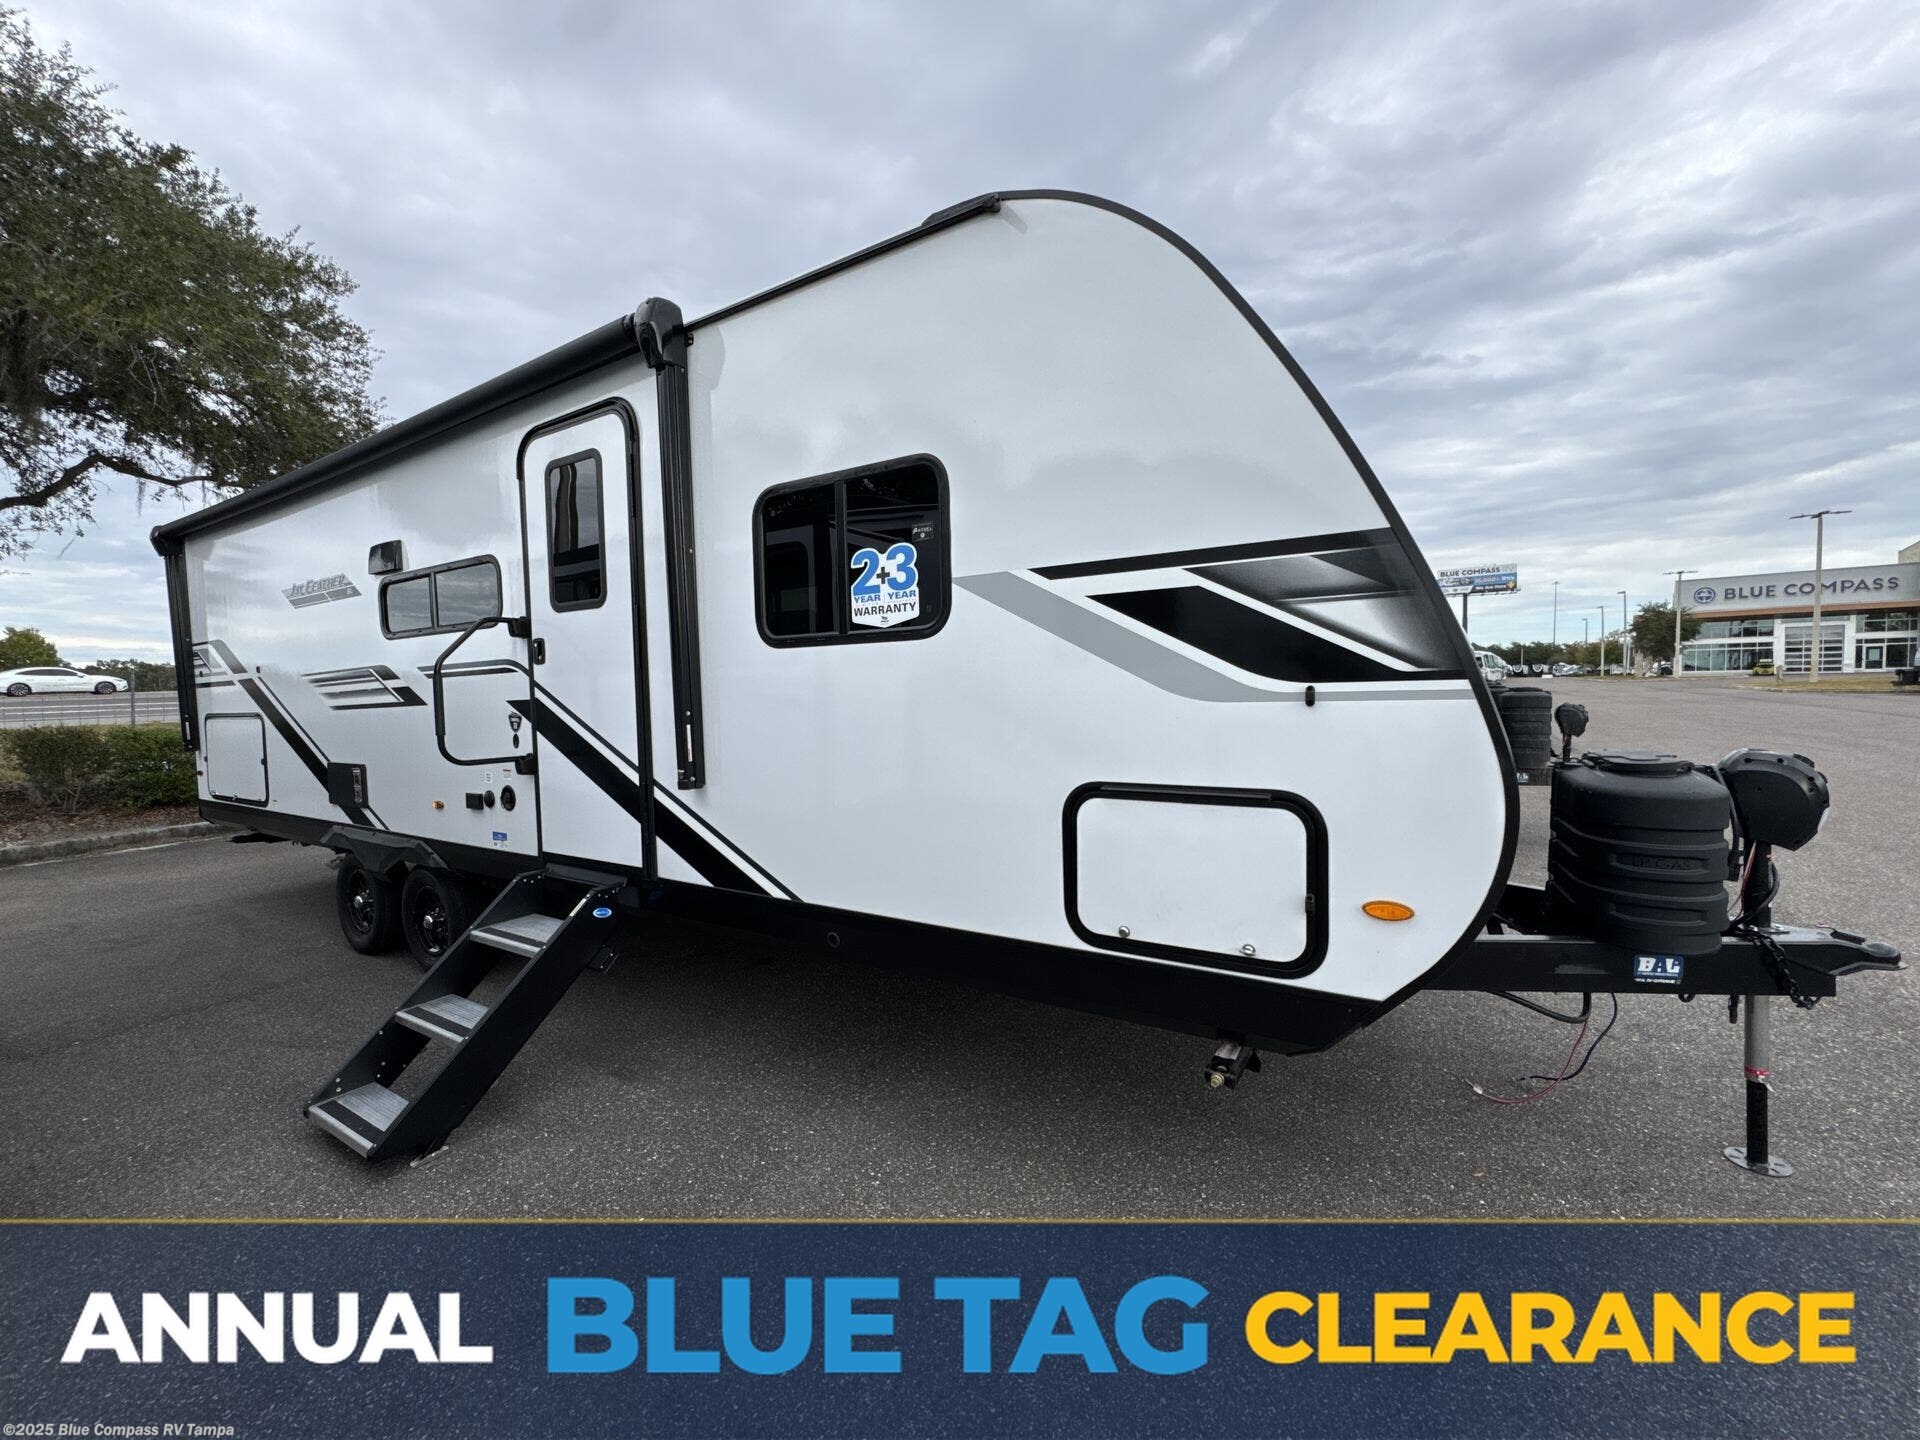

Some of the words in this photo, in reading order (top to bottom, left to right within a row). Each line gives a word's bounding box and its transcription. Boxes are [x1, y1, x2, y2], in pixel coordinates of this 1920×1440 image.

[1440, 570, 1460, 578] BLUE
[1461, 566, 1500, 576] COMPASS
[1724, 584, 1776, 600] BLUE
[1784, 576, 1899, 596] COMPASS
[854, 594, 881, 604] YEAR
[887, 589, 917, 600] YEAR
[853, 601, 917, 617] WARRANTY
